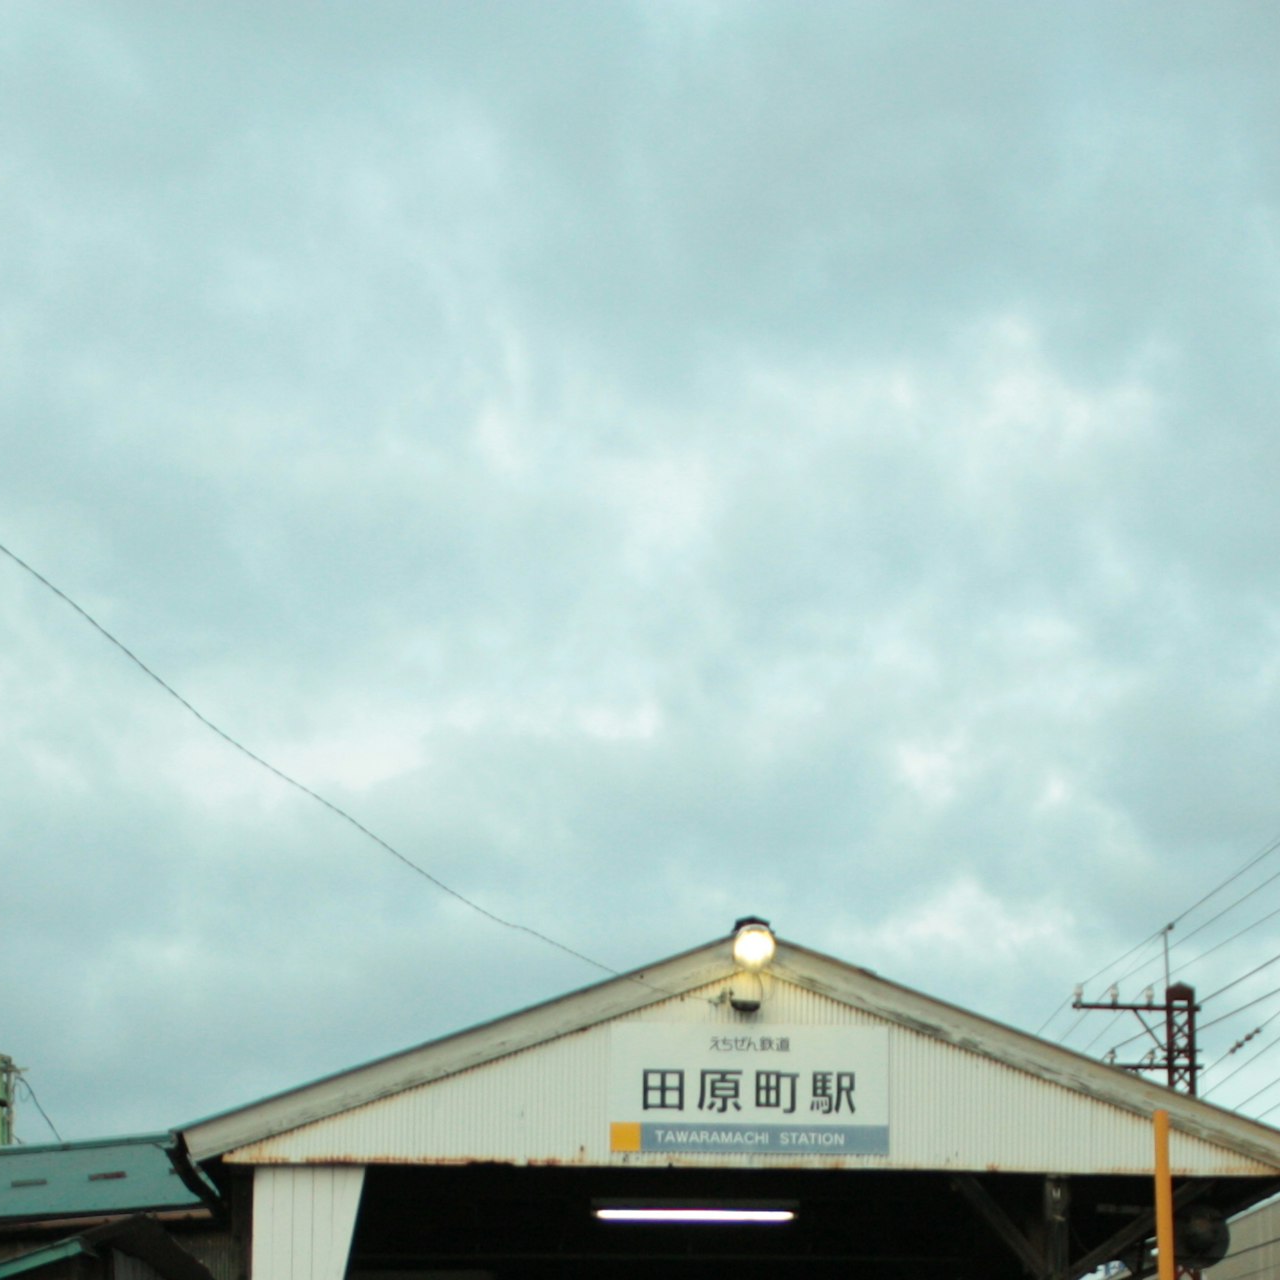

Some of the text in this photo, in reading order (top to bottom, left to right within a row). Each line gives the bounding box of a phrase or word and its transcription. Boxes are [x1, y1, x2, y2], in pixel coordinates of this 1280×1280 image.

[709, 1036, 790, 1053] えちぜん鉄道
[642, 1068, 856, 1115] 田原町駅
[655, 1130, 845, 1146] TAWARAMACHI STATION
